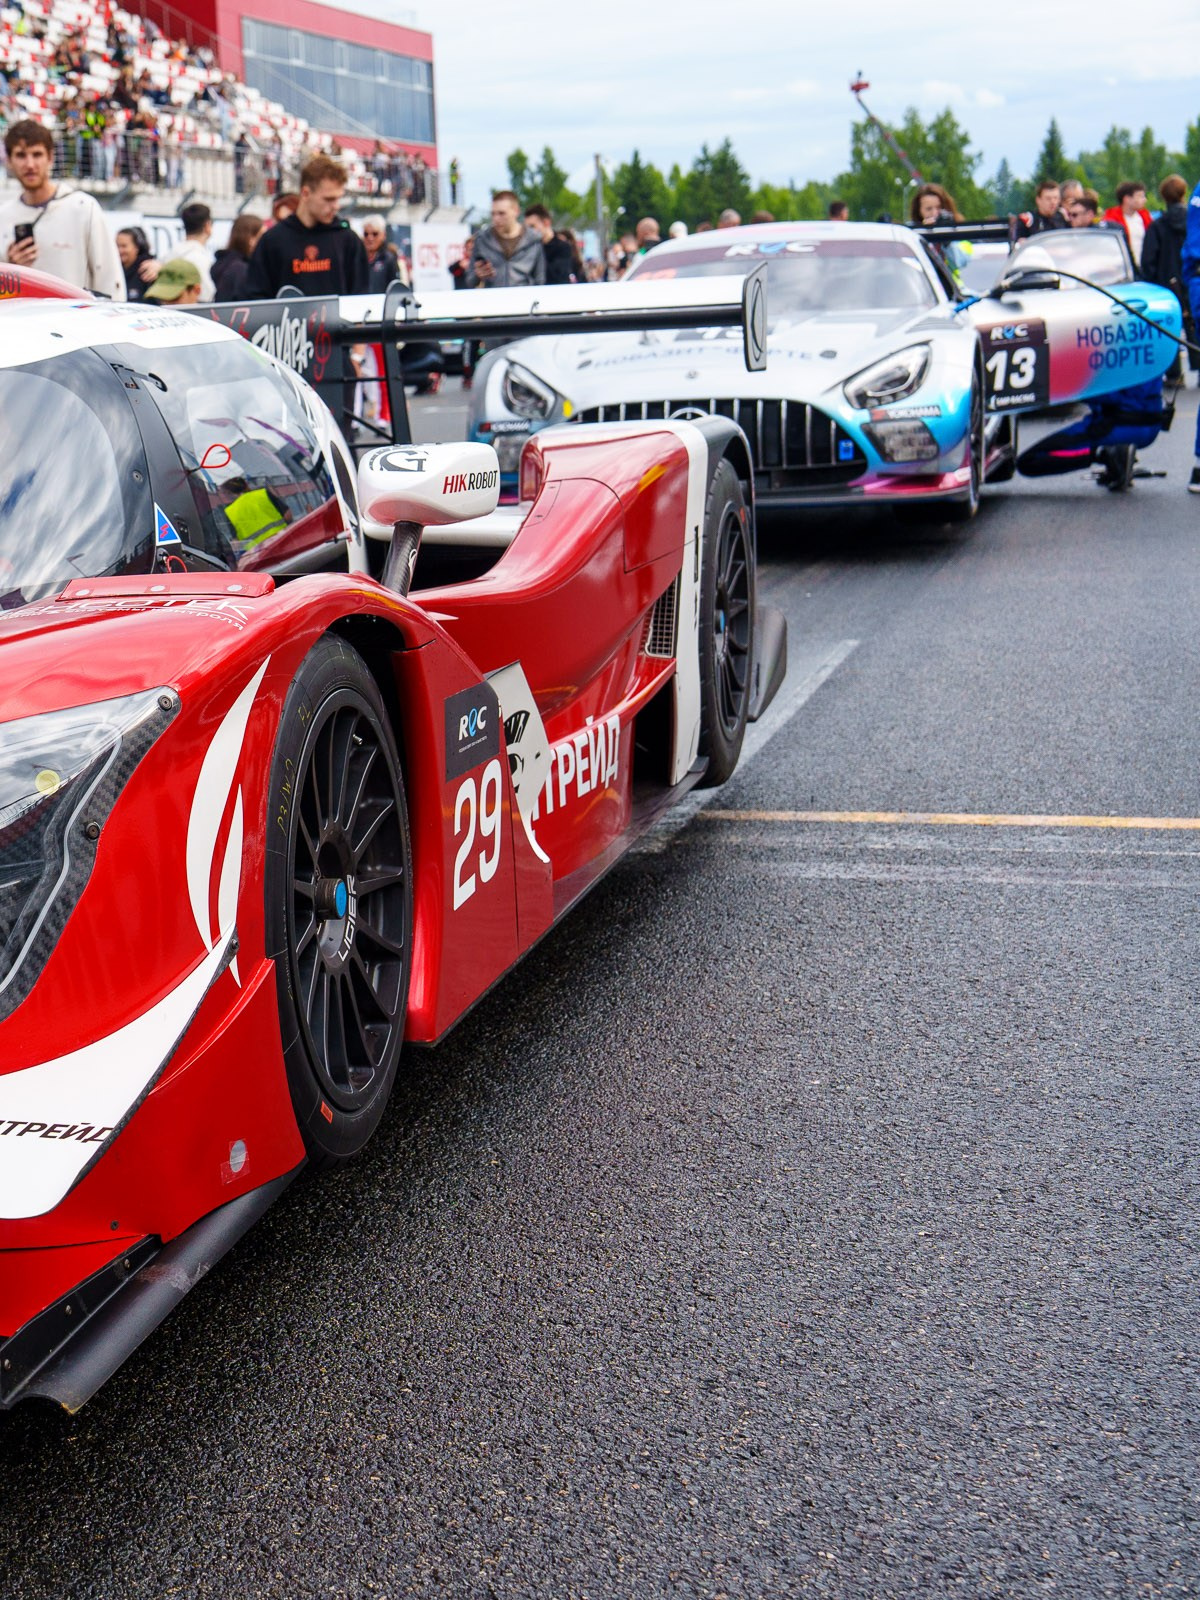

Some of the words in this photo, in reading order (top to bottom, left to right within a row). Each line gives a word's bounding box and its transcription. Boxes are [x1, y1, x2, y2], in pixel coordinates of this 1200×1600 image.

[986, 347, 1036, 391] 13
[1088, 344, 1155, 370] ФОРТЕ
[442, 470, 499, 495] HIKROBOT
[453, 758, 503, 912] 29
[338, 874, 357, 962] LIGIER
